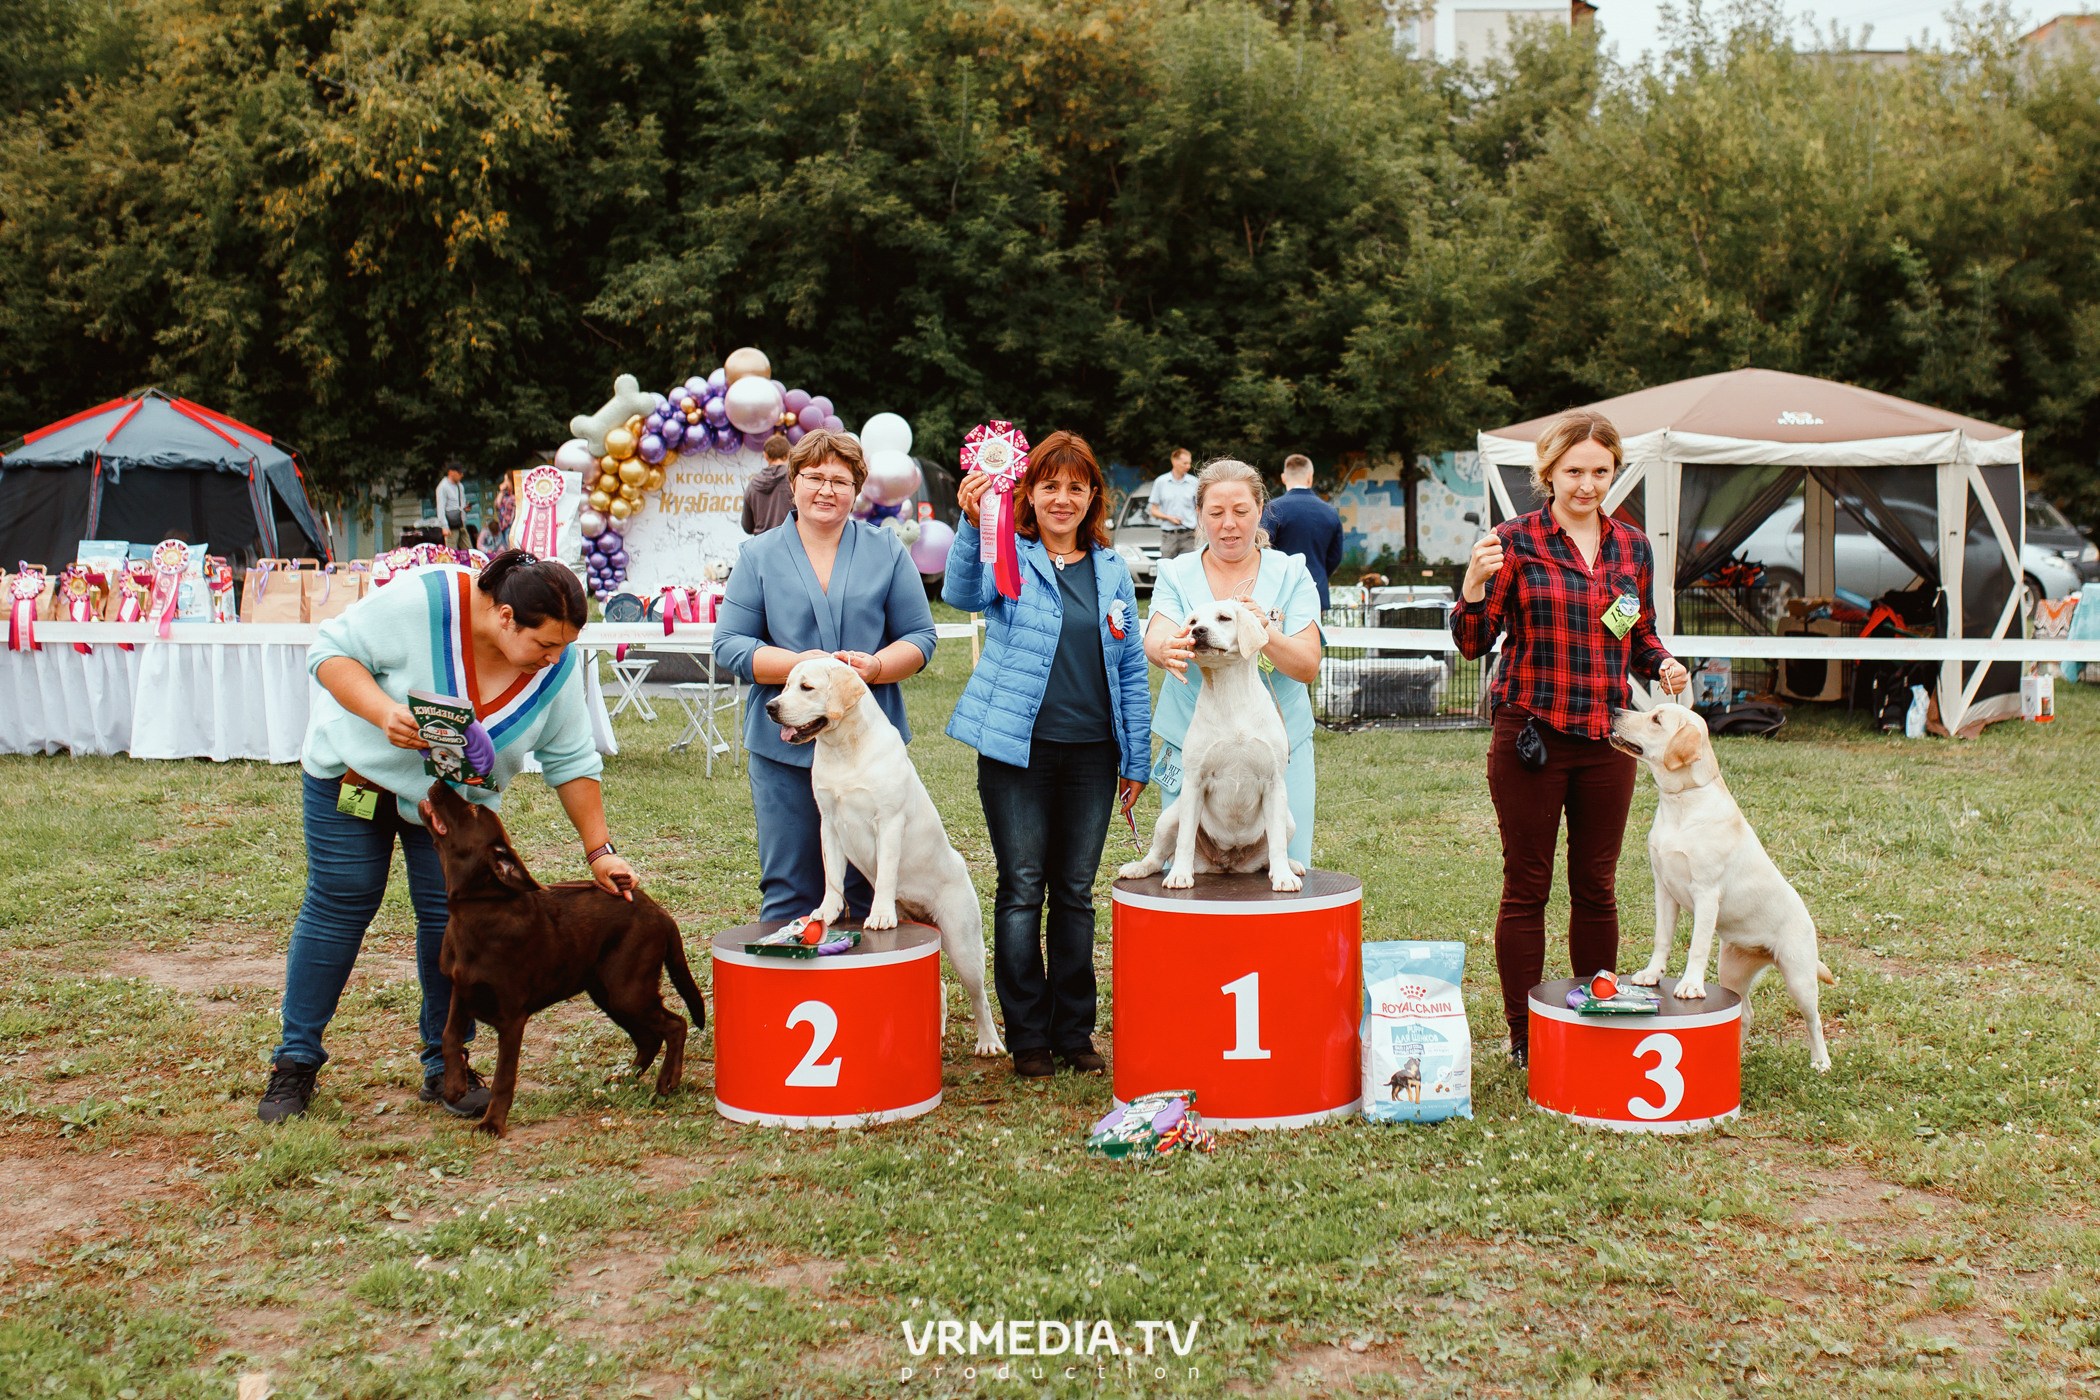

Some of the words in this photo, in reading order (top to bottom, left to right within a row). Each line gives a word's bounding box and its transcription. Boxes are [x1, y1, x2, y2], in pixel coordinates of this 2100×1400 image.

[676, 472, 735, 485] КГООКК
[659, 492, 745, 515] Кузбасс
[413, 705, 468, 724] СУПЕРДИСК
[348, 790, 366, 803] 21
[1221, 972, 1271, 1060] 1
[1382, 1001, 1415, 1014] ROYAL
[1415, 1002, 1452, 1014] CANIN
[785, 1000, 842, 1087] 2
[1627, 1033, 1685, 1120] 3
